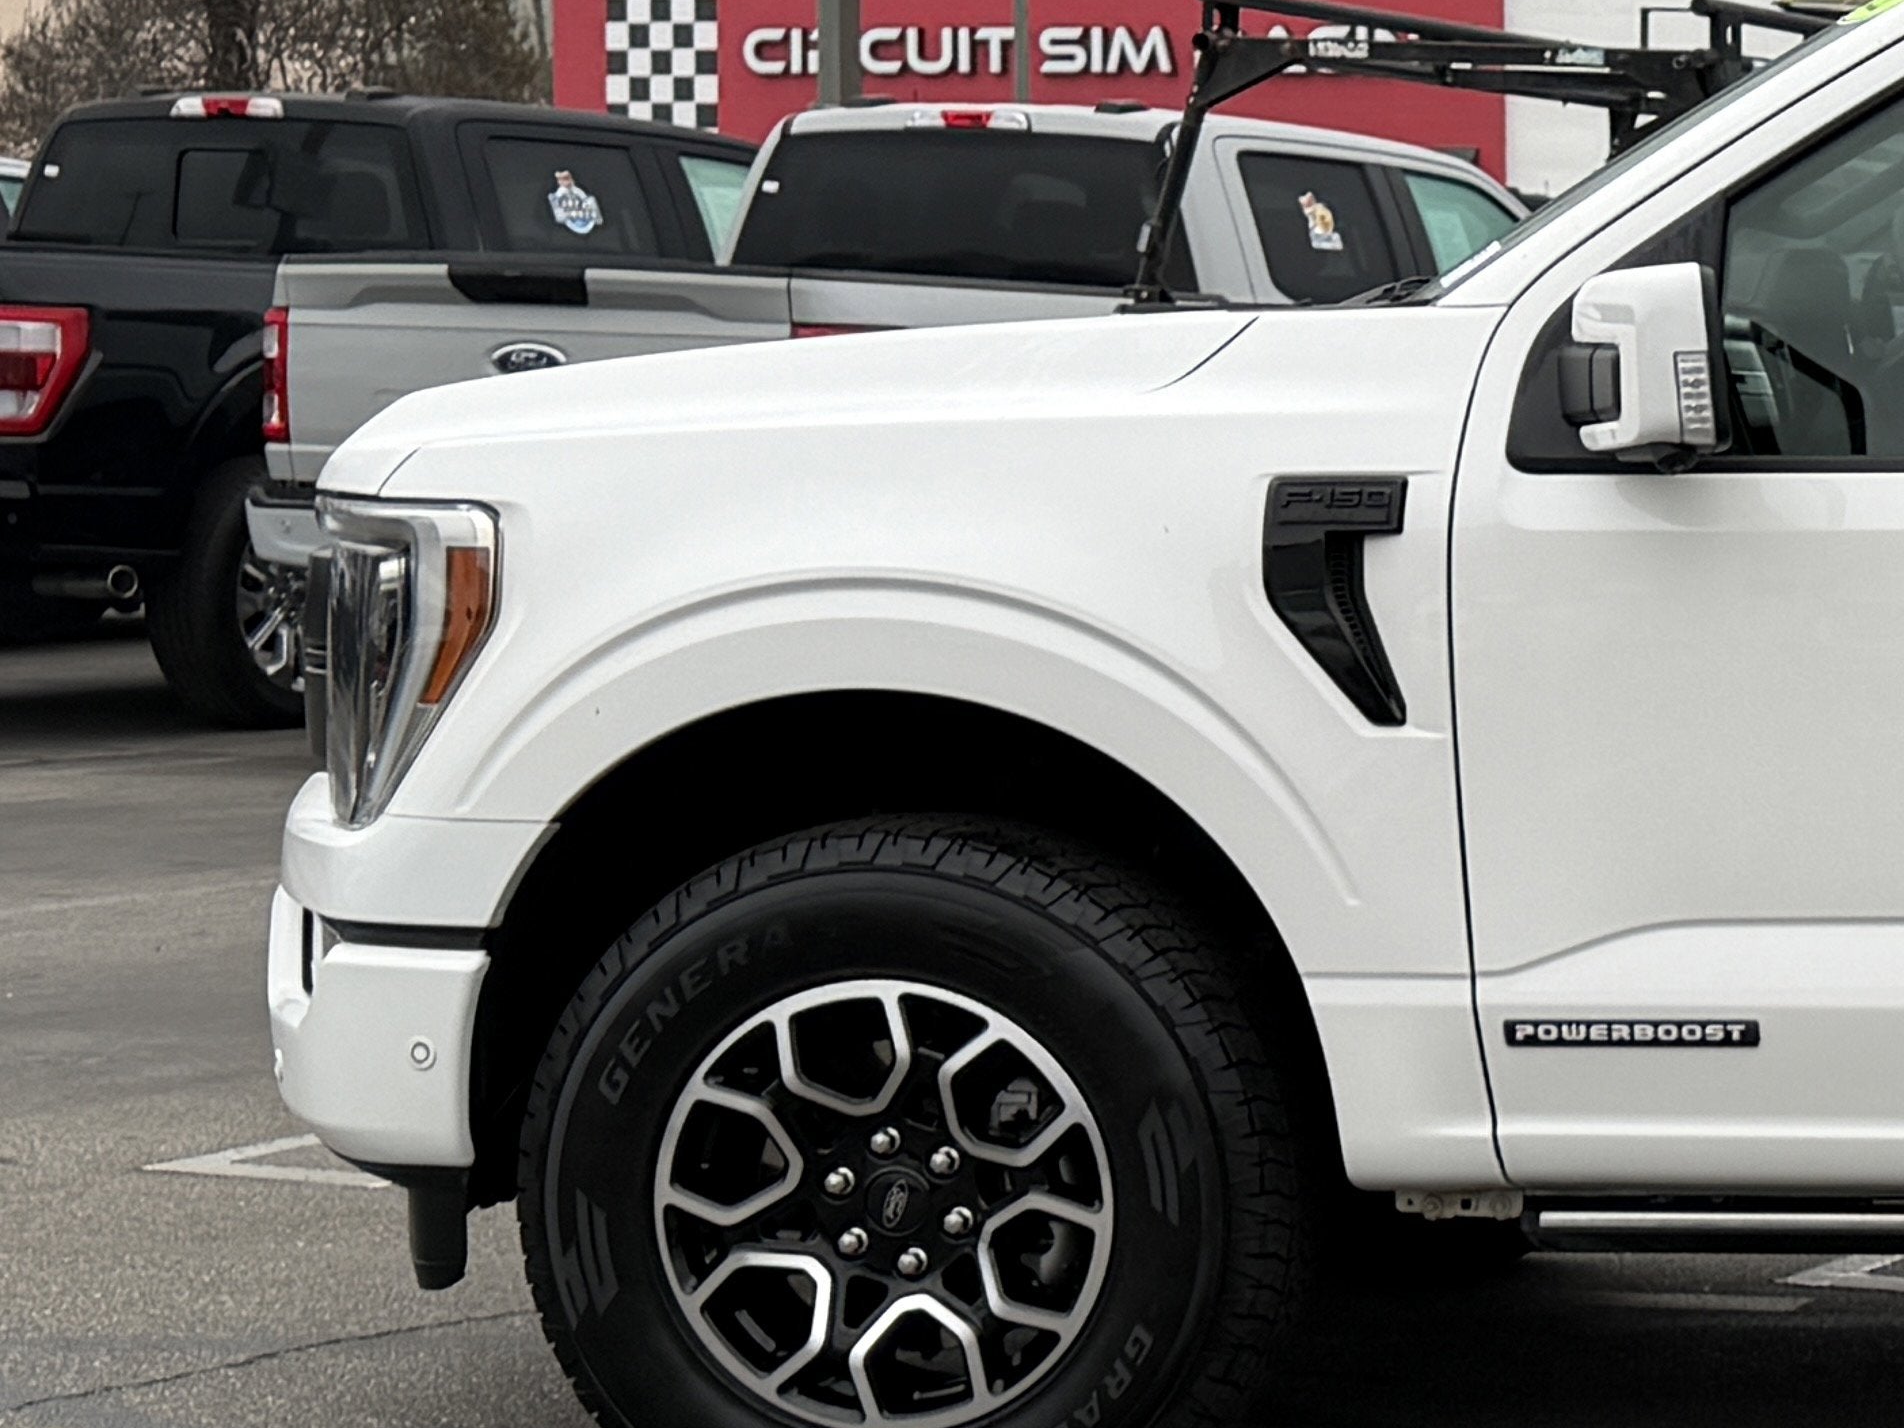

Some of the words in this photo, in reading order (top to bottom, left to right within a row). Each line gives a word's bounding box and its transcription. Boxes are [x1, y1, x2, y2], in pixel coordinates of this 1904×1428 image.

[743, 27, 1015, 74] CICUIT
[1039, 25, 1173, 74] SIM
[1281, 488, 1392, 509] F-150
[598, 920, 838, 1105] GENERA
[1515, 1023, 1746, 1042] POWERBOOST
